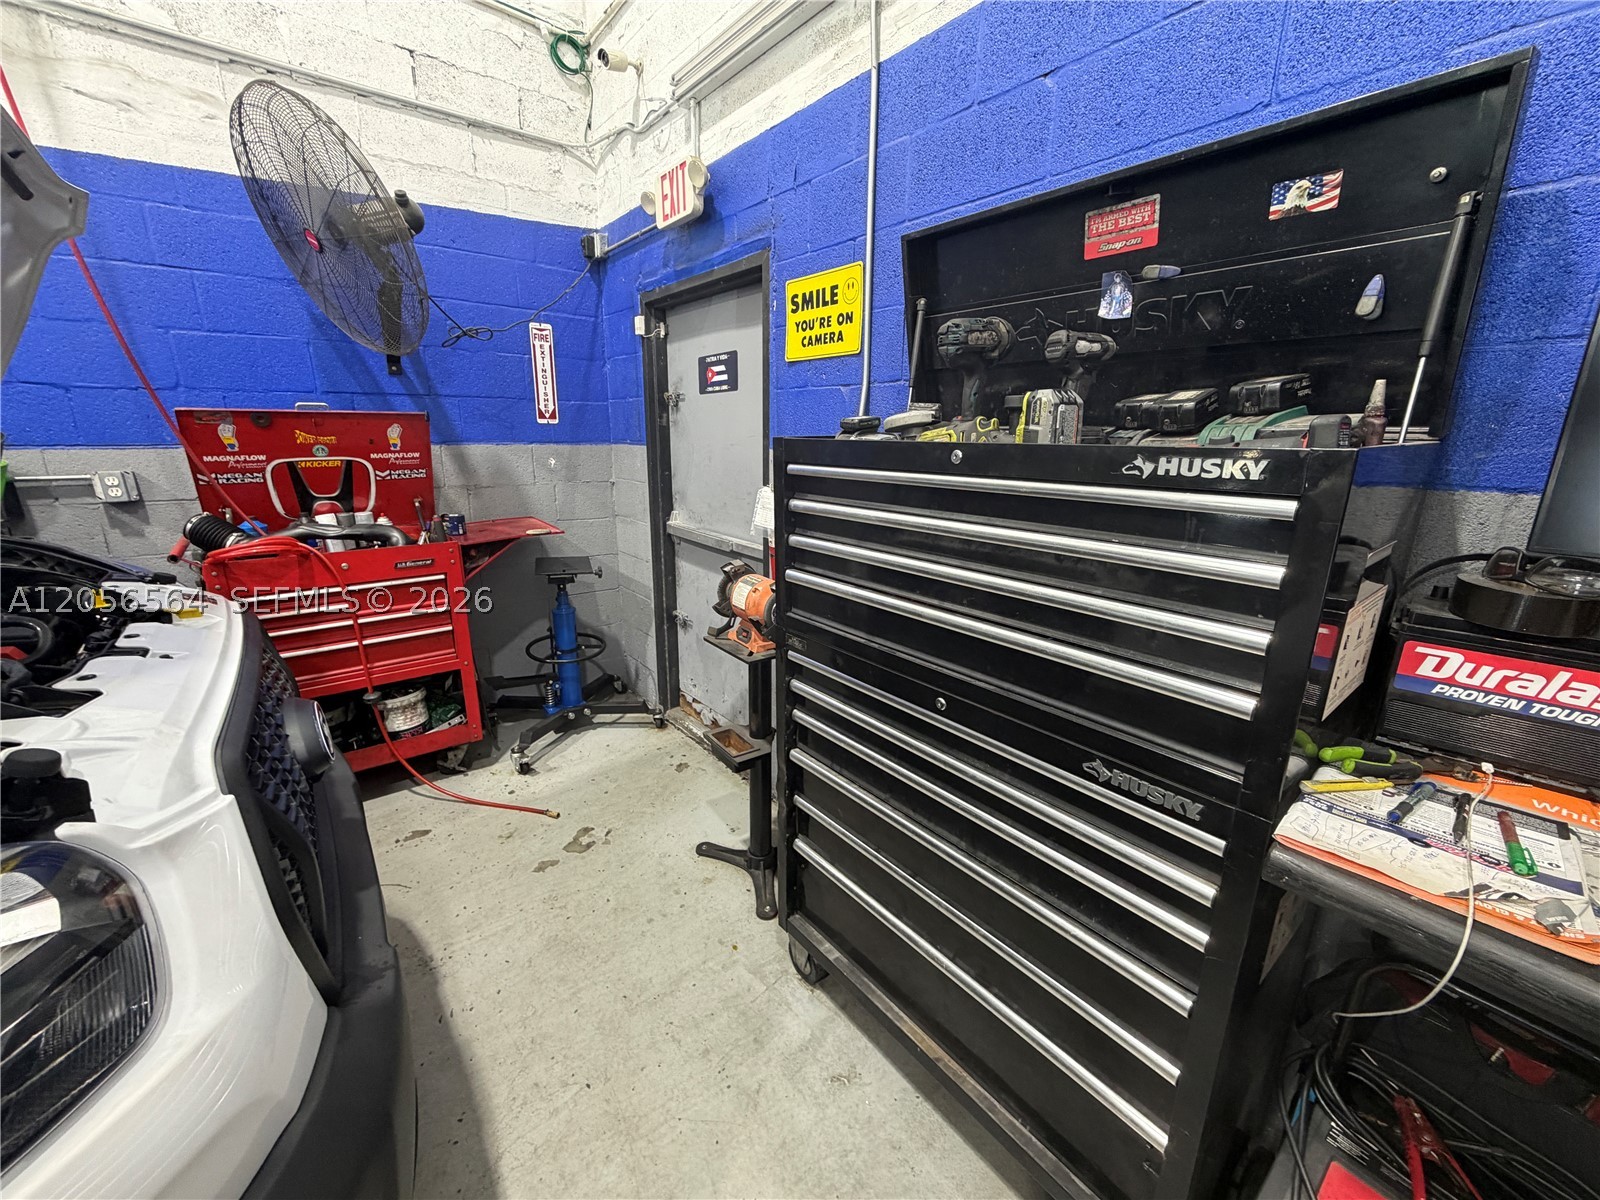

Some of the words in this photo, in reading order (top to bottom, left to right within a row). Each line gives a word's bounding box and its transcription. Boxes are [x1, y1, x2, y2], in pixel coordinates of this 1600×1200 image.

[660, 160, 687, 222] EXIT
[1090, 220, 1115, 234] THE
[1118, 211, 1151, 228] BEST
[1103, 210, 1129, 222] ARMED
[1131, 204, 1151, 215] WITH
[790, 284, 839, 314] SMILE
[795, 315, 832, 333] YOU'RE
[837, 311, 854, 326] ON
[533, 333, 550, 343] FIRE
[801, 330, 844, 348] CAMERA
[539, 344, 550, 415] EXTINGUISHER
[1157, 457, 1270, 481] HUSKY
[1431, 684, 1528, 711] PROVEN
[1111, 769, 1204, 819] HUSKY
